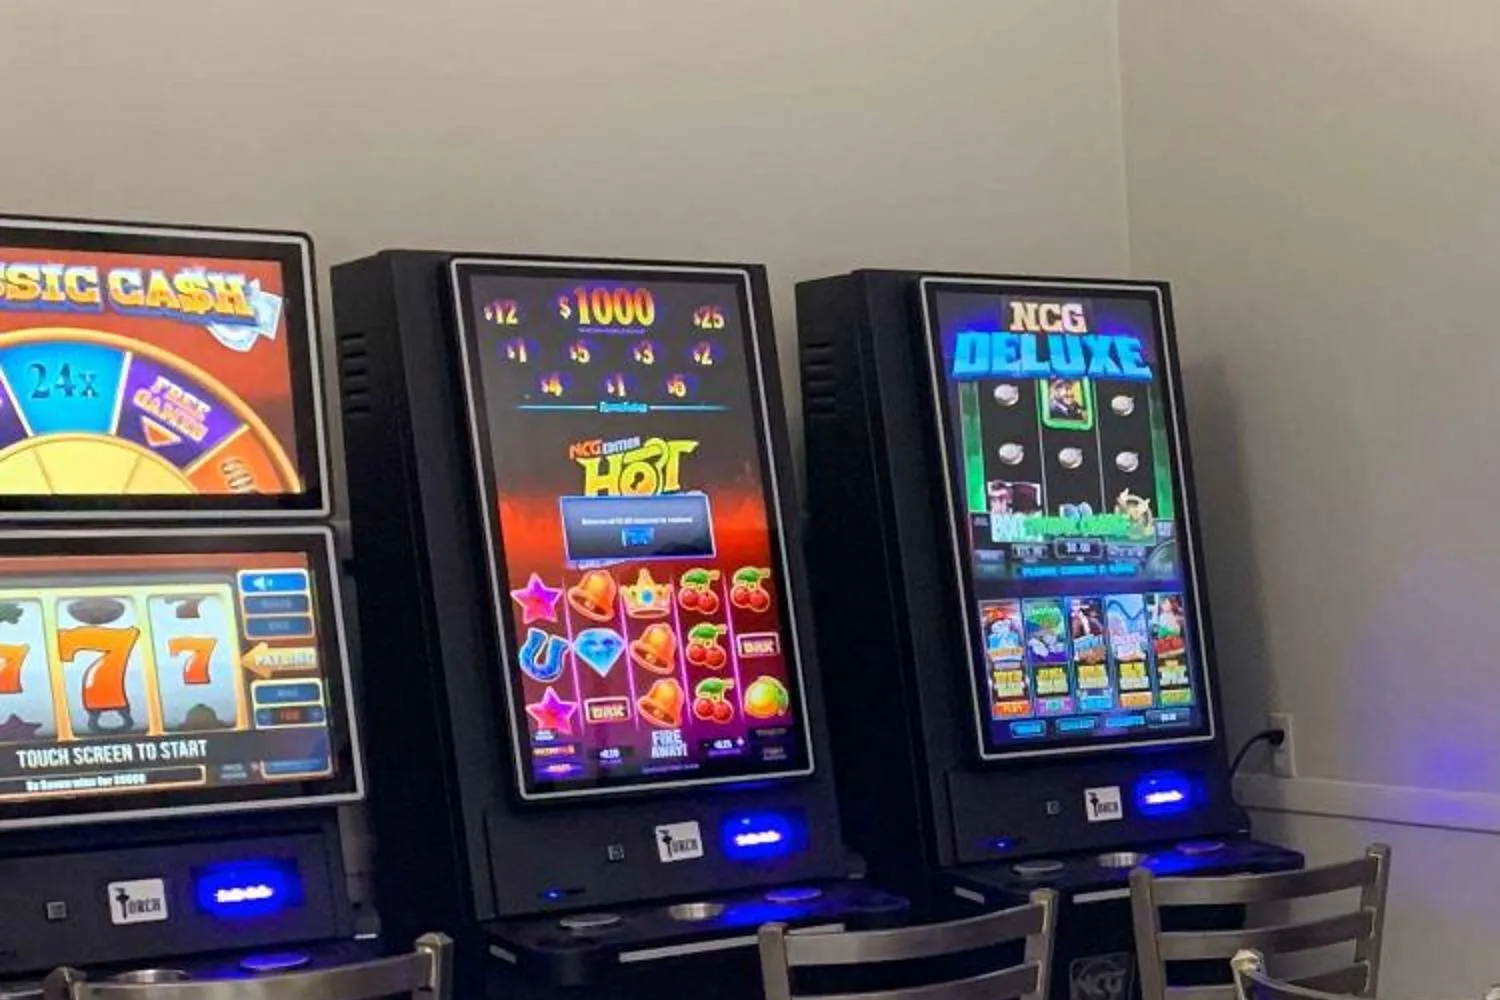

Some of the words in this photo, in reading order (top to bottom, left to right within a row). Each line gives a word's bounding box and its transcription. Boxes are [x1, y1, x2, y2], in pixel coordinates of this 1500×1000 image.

[0, 261, 100, 311] SIC
[559, 287, 656, 326] $1000
[1010, 301, 1087, 333] NCG
[952, 332, 1152, 381] DELUXE
[29, 362, 99, 400] 24x
[577, 437, 699, 496] HOT
[16, 749, 69, 768] TOUCH
[72, 744, 133, 765] SCREEN
[136, 742, 156, 760] TO
[159, 739, 208, 759] START
